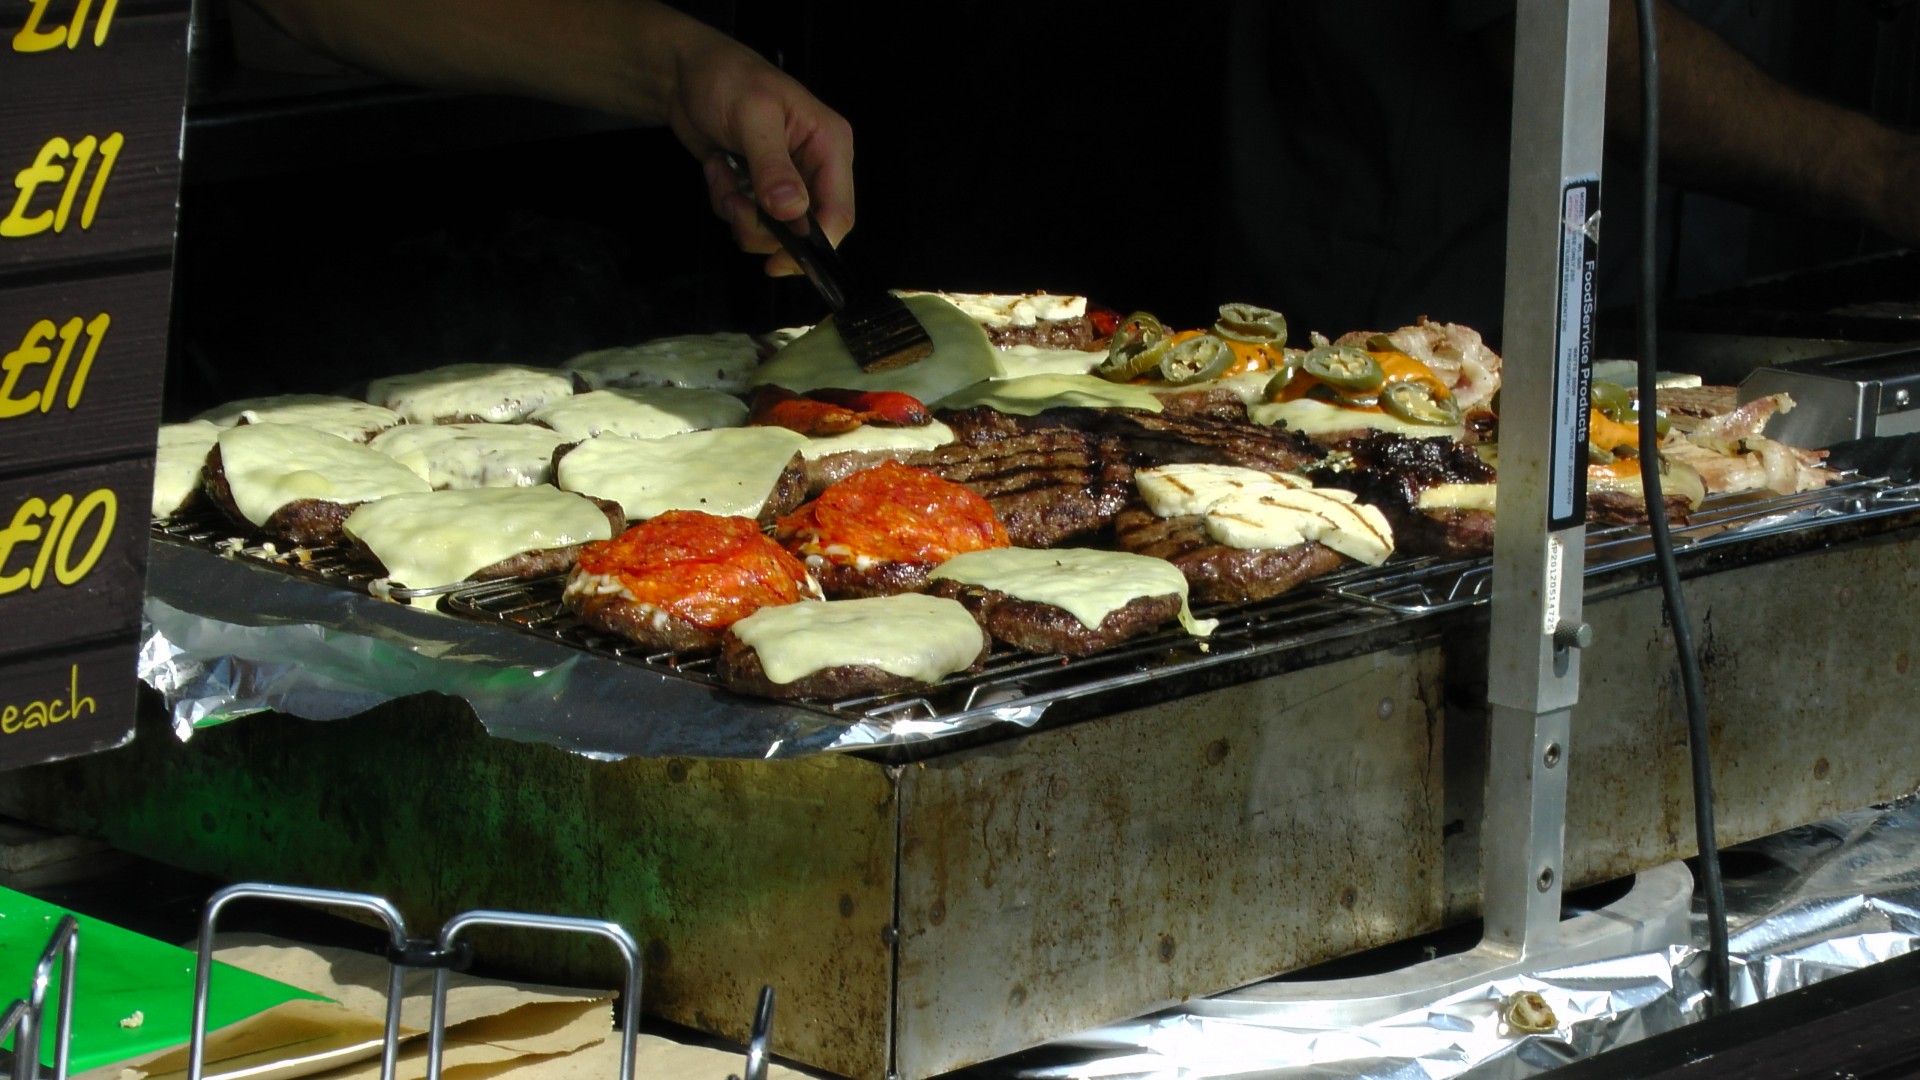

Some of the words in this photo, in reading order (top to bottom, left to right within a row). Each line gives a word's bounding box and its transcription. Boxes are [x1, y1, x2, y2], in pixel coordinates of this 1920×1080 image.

[0, 131, 124, 238] £11
[1581, 260, 1595, 364] FoodService
[0, 312, 111, 419] £11
[1578, 368, 1590, 442] Products
[0, 488, 118, 595] £10
[1, 663, 95, 734] each
